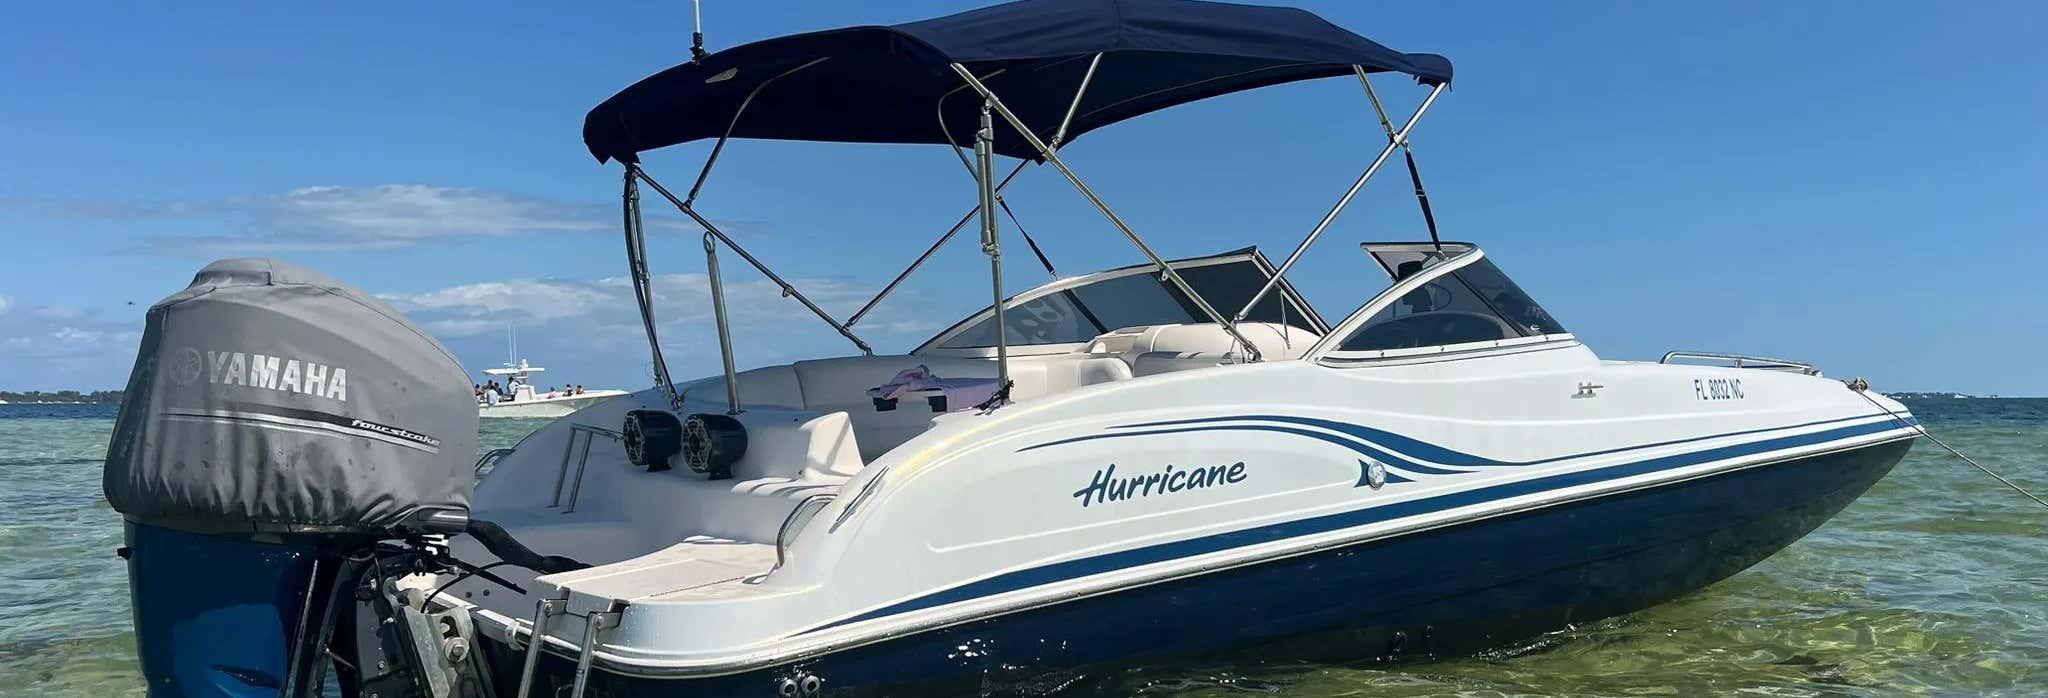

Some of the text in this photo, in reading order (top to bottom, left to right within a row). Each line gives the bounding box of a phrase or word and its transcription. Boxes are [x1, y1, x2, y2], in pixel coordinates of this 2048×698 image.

[207, 351, 346, 401] YAMAHA
[1694, 379, 1744, 400] FL 8032 NC
[1073, 461, 1248, 508] Hurricane
